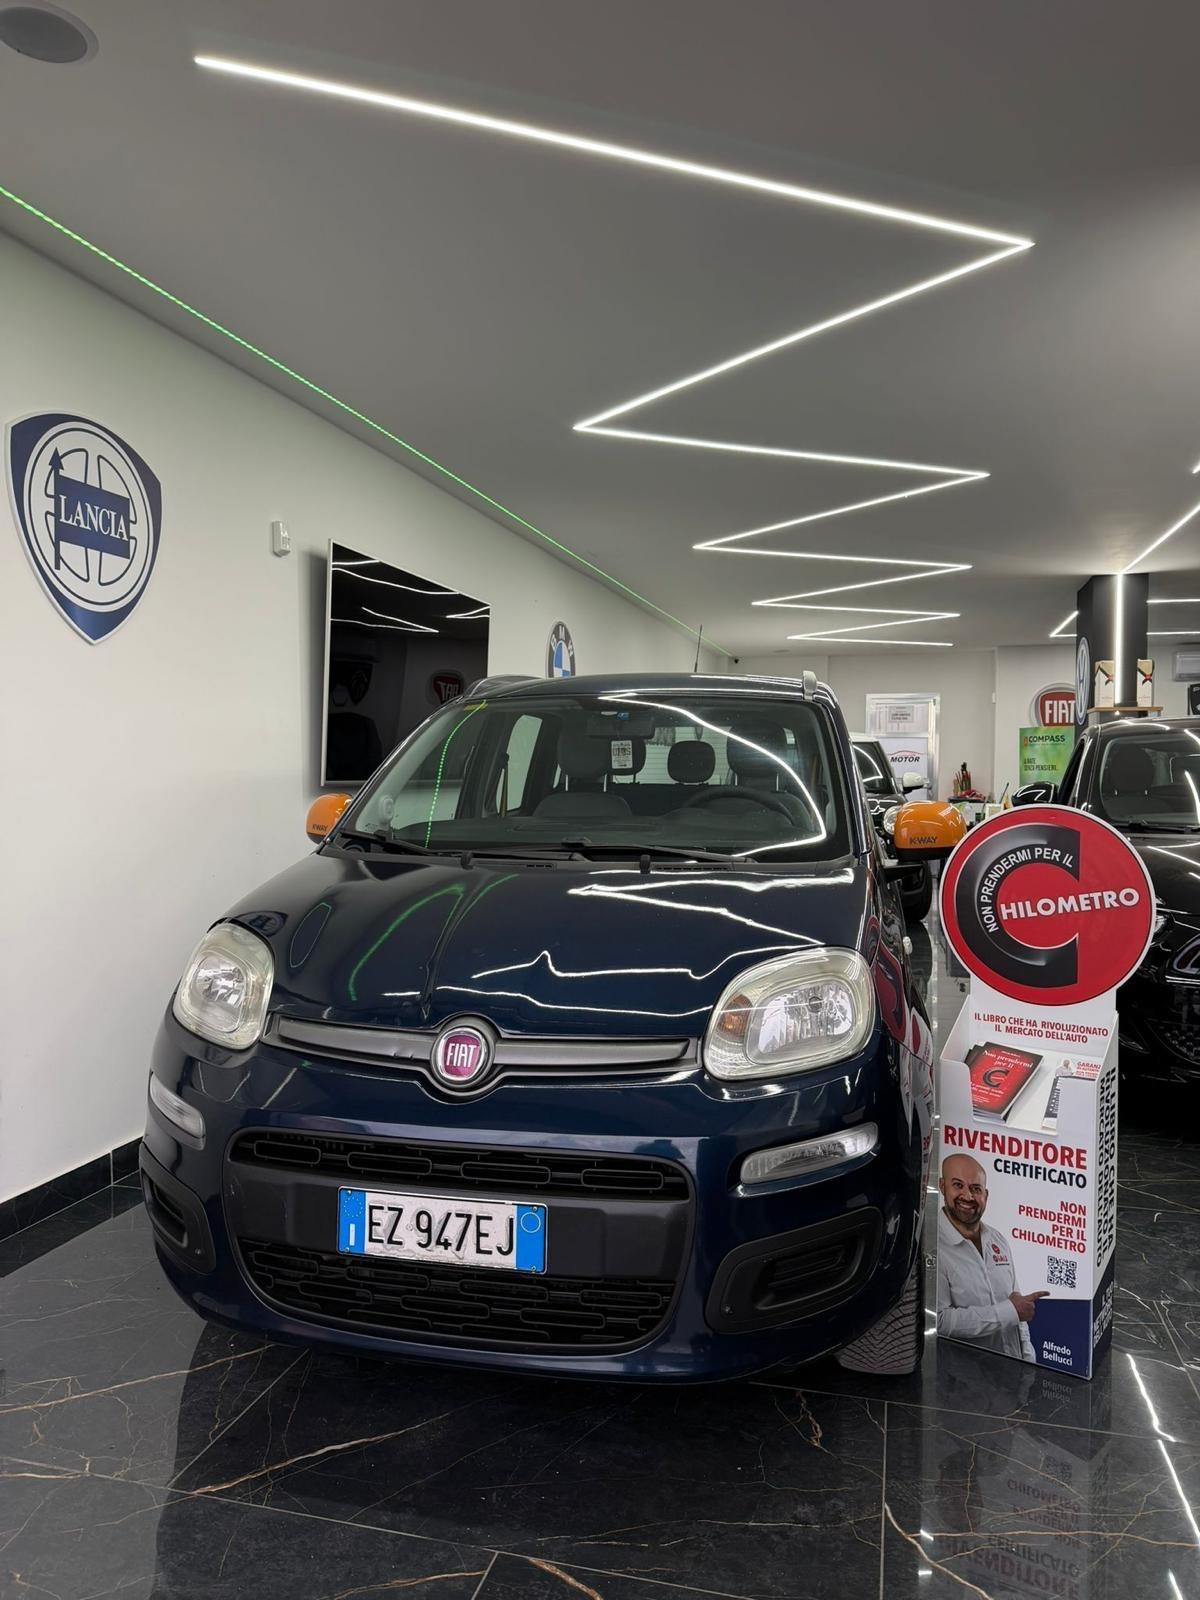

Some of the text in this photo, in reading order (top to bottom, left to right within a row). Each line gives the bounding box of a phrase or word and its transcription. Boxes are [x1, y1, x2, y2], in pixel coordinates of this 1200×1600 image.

[59, 494, 129, 542] LANCIA
[550, 625, 574, 656] BMW
[1045, 700, 1076, 724] FIAT
[980, 847, 1074, 933] NON PRENDERMI PER IL
[974, 1012, 1109, 1037] IL LIBRO CHE HA RIVOLUZIONATO
[994, 1025, 1088, 1044] IL MERCATO DELL'AUTO
[446, 1043, 477, 1068] FIAT
[1109, 1066, 1116, 1086] IL
[944, 1125, 1088, 1170] RIVENDITORE
[993, 1158, 1087, 1188] CERTIFICATO
[1018, 1204, 1087, 1229] PRENDERMI
[1060, 1200, 1087, 1217] NON
[349, 1204, 514, 1256] I EZ 947EJ
[1011, 1228, 1086, 1254] CHILOMETRO
[1051, 1224, 1087, 1242] PER IL
[1107, 1215, 1114, 1248] HA
[1042, 1340, 1072, 1356] Alfredo
[1042, 1350, 1073, 1367] Bellucci
